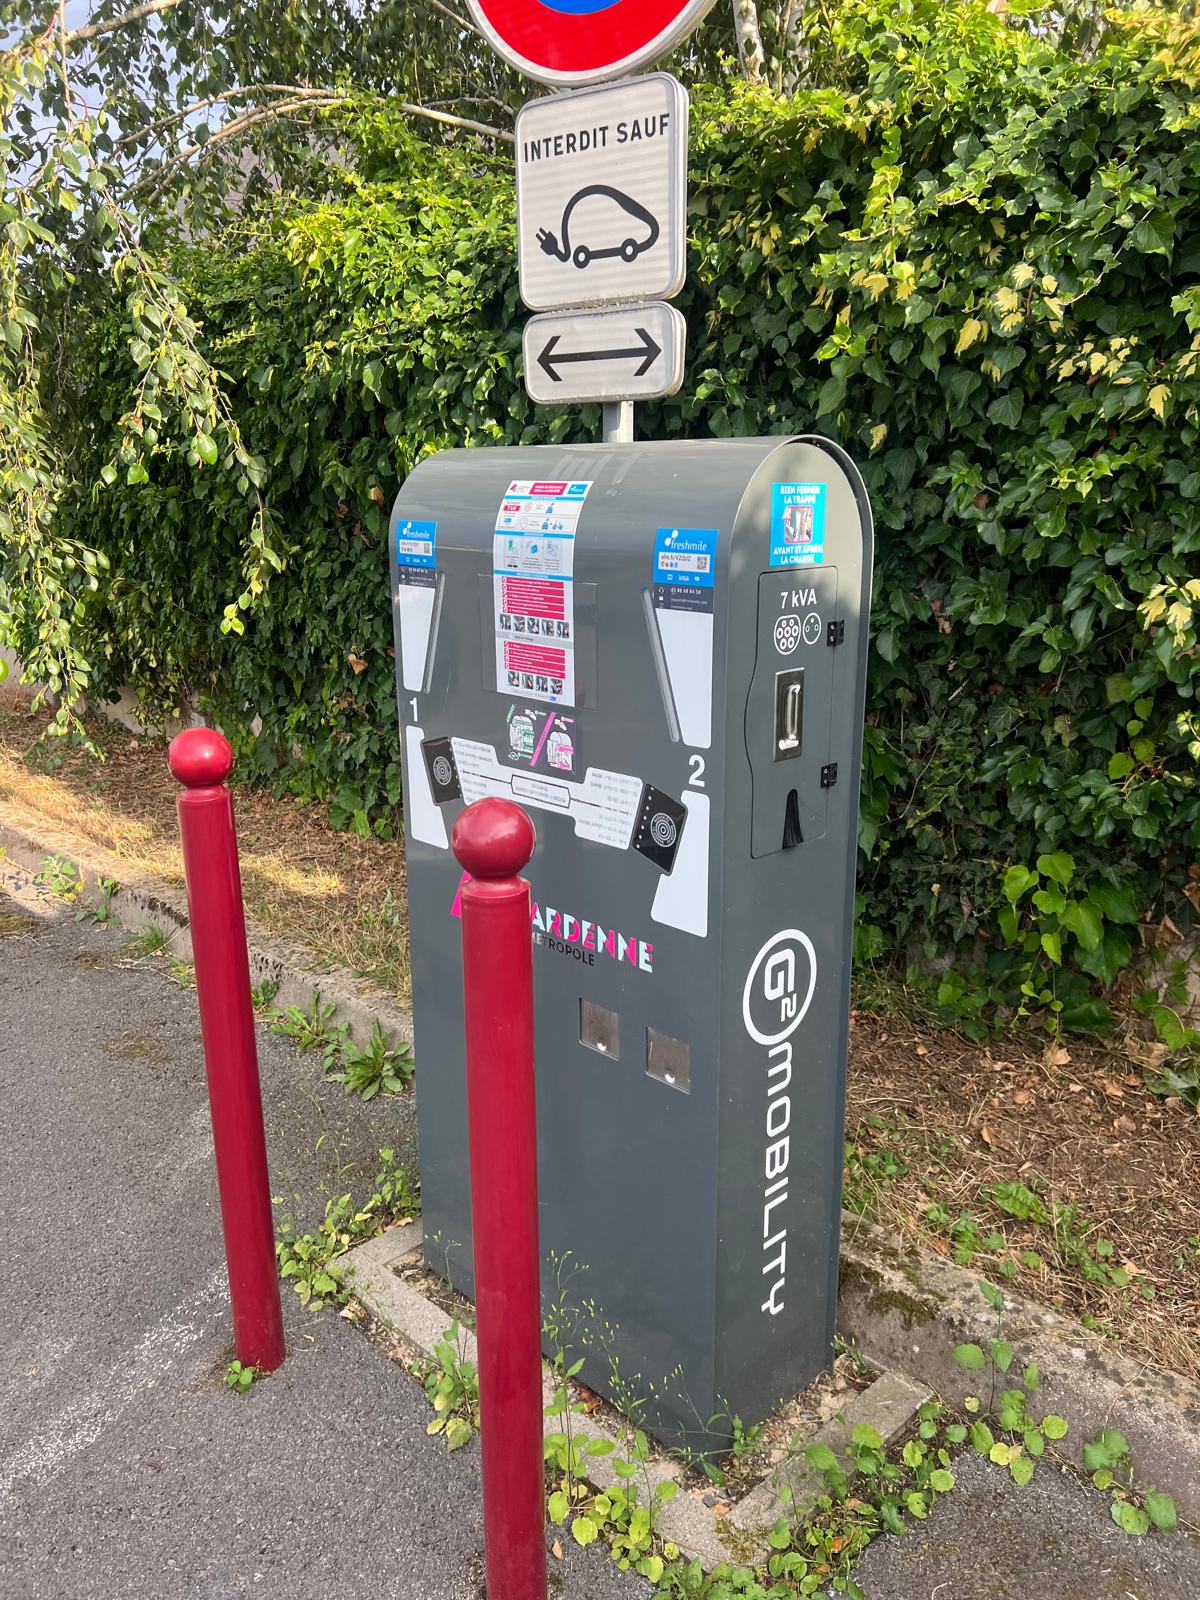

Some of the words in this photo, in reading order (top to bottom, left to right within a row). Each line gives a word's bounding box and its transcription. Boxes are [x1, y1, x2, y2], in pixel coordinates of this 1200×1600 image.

[524, 126, 609, 162] INTERDIT
[616, 113, 670, 143] SAUF
[784, 496, 792, 504] LA
[793, 495, 816, 504] TRAPPE
[671, 540, 707, 551] freshmile
[773, 546, 794, 555] AVANT
[780, 557, 789, 565] LA
[780, 592, 789, 609] 7
[791, 588, 817, 608] kVA
[409, 697, 418, 722] 1
[688, 754, 706, 788] 2
[531, 902, 653, 973] ARDENNE
